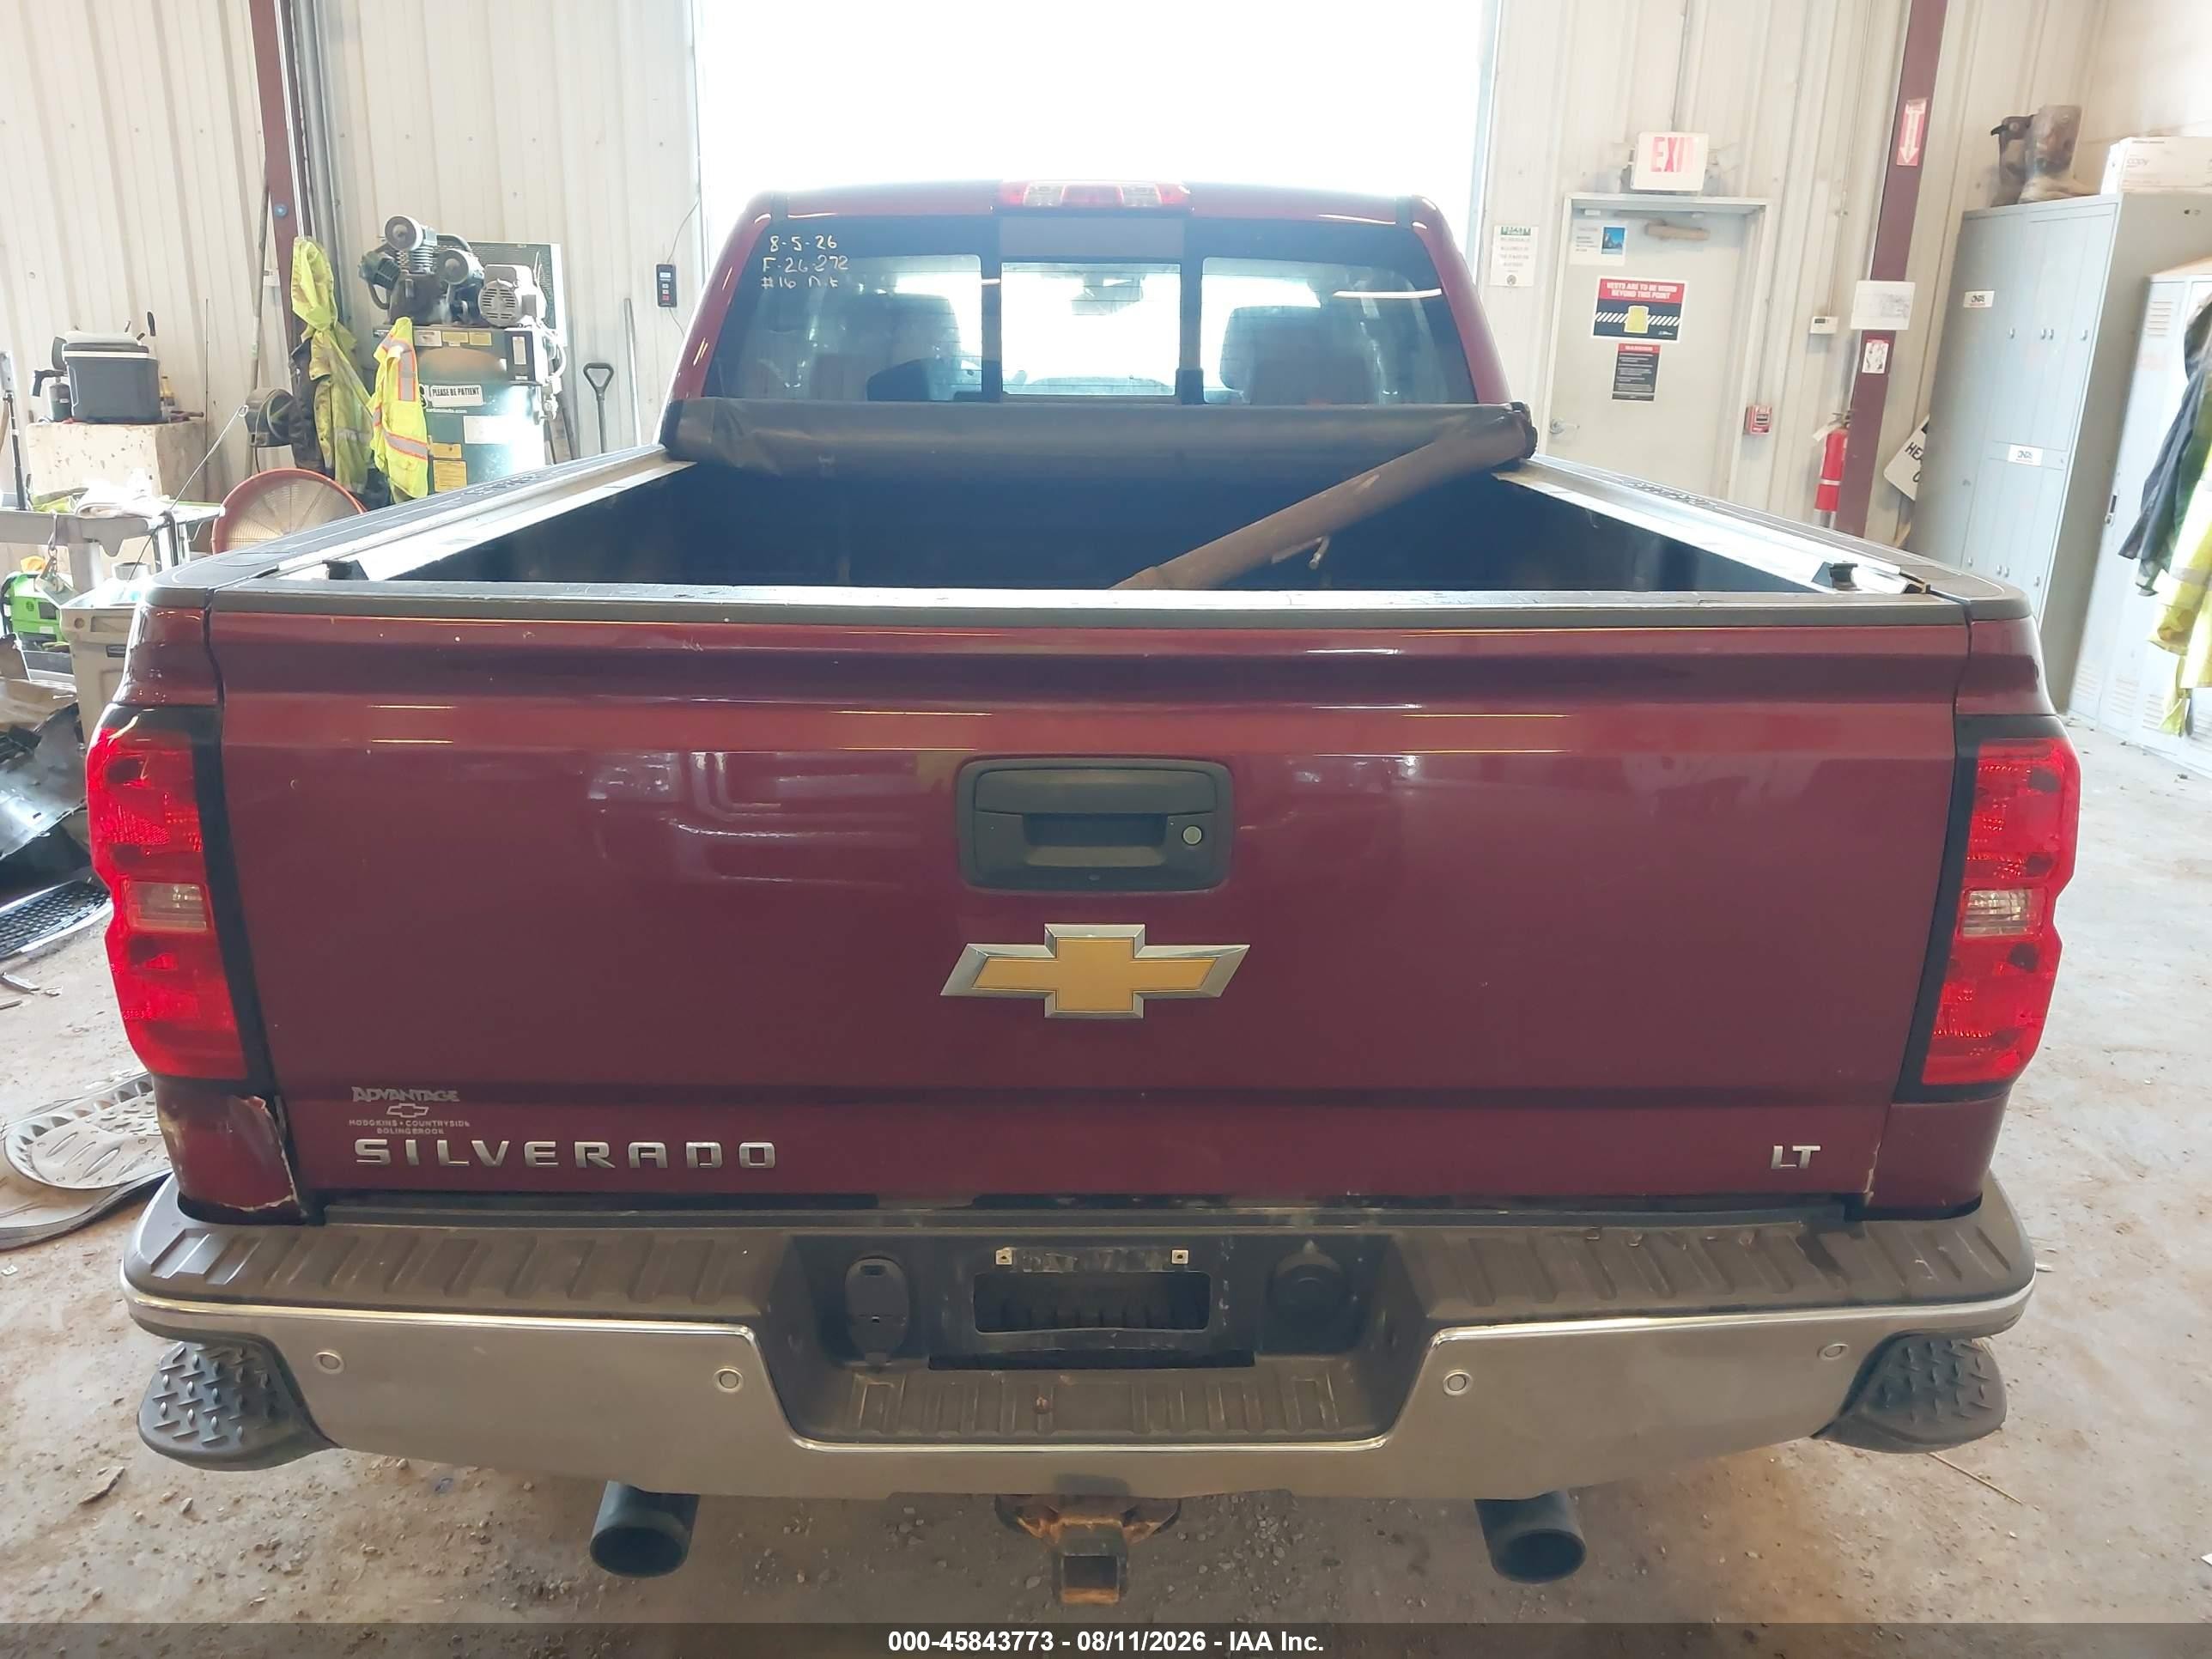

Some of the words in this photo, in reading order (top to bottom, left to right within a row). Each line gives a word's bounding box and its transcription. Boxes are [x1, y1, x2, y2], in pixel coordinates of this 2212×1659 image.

[769, 234, 837, 252] 8-5-26
[458, 387, 479, 396] PATIENT
[351, 1086, 460, 1103] ADVANTAGE
[349, 1119, 398, 1127] HODGKINS
[405, 1119, 471, 1127] COUNTRYSIDE
[354, 1139, 776, 1169] SILVERADO
[1771, 1145, 1821, 1170] LT
